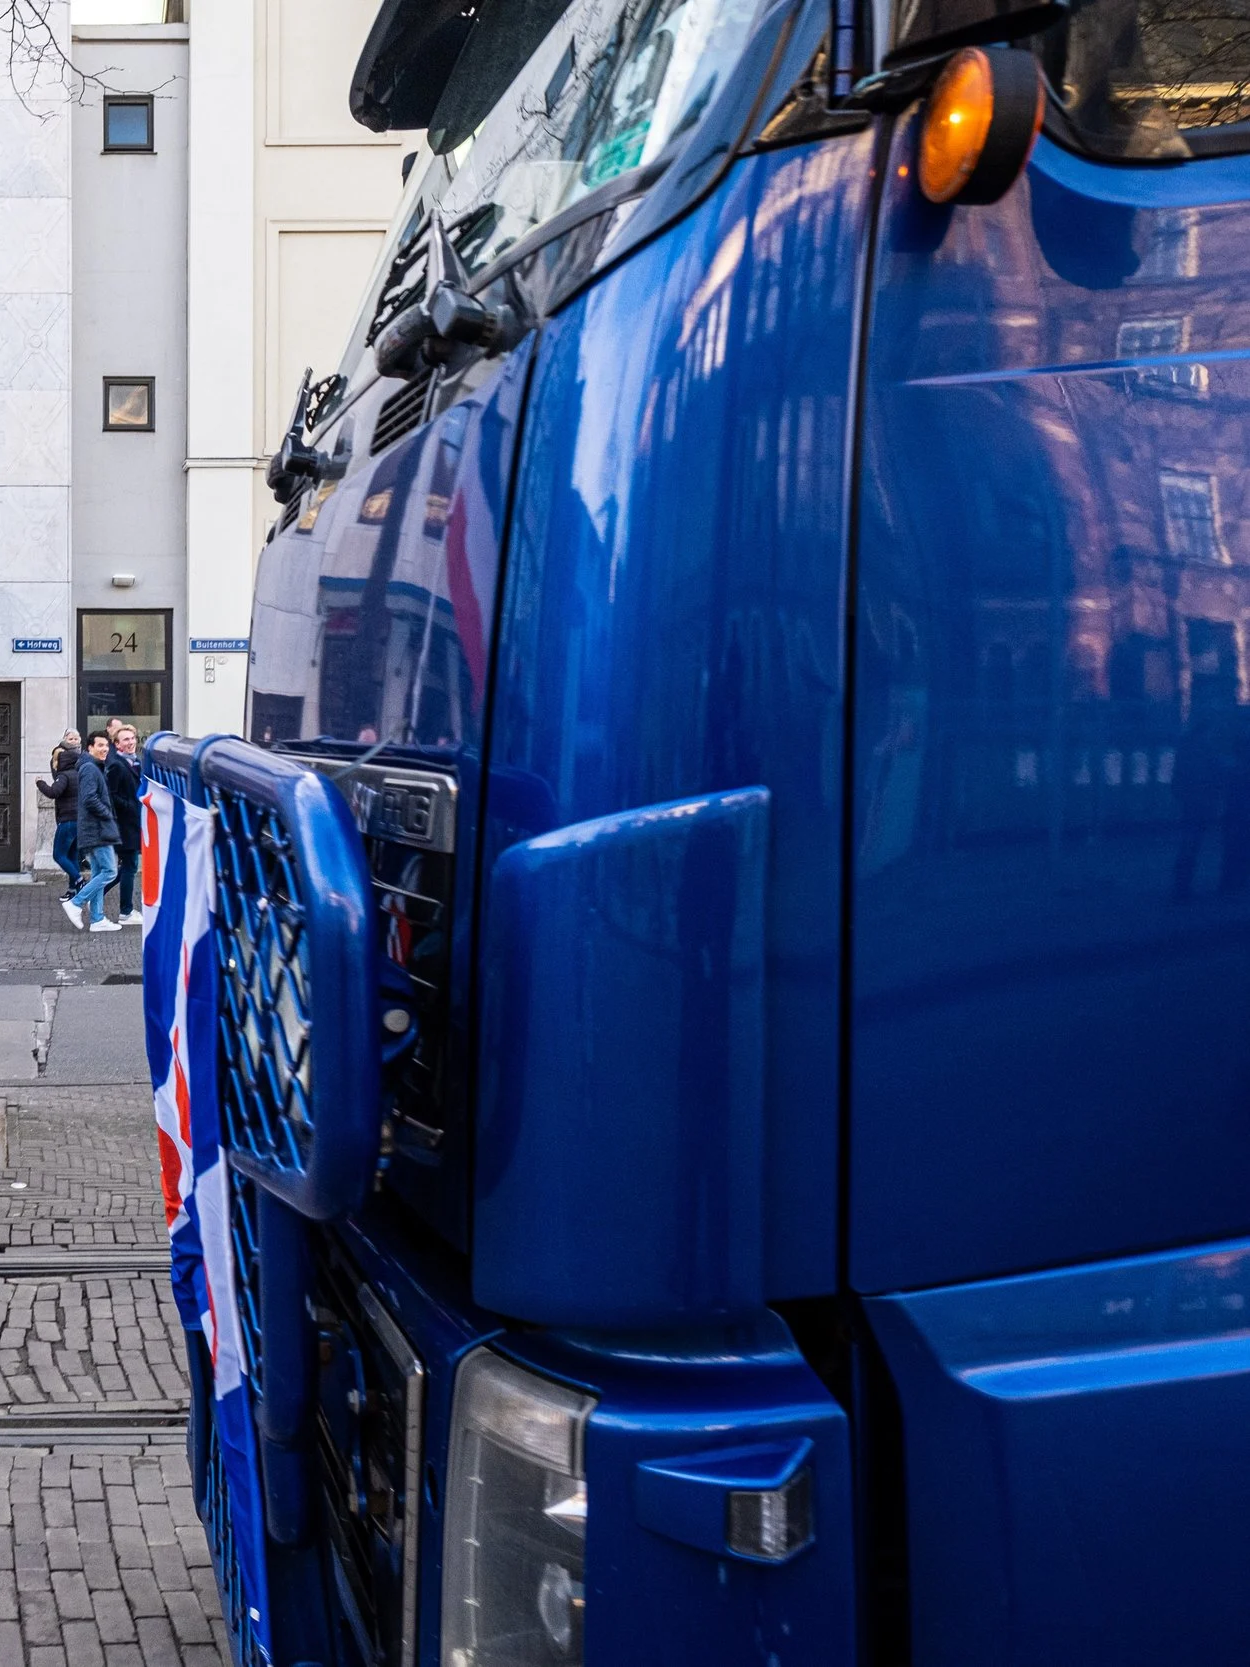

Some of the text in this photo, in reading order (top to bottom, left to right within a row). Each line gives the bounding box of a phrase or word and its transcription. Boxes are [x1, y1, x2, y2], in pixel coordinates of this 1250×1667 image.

[26, 641, 58, 650] Hofweg
[110, 632, 138, 653] 24
[196, 641, 236, 649] Buitenhof
